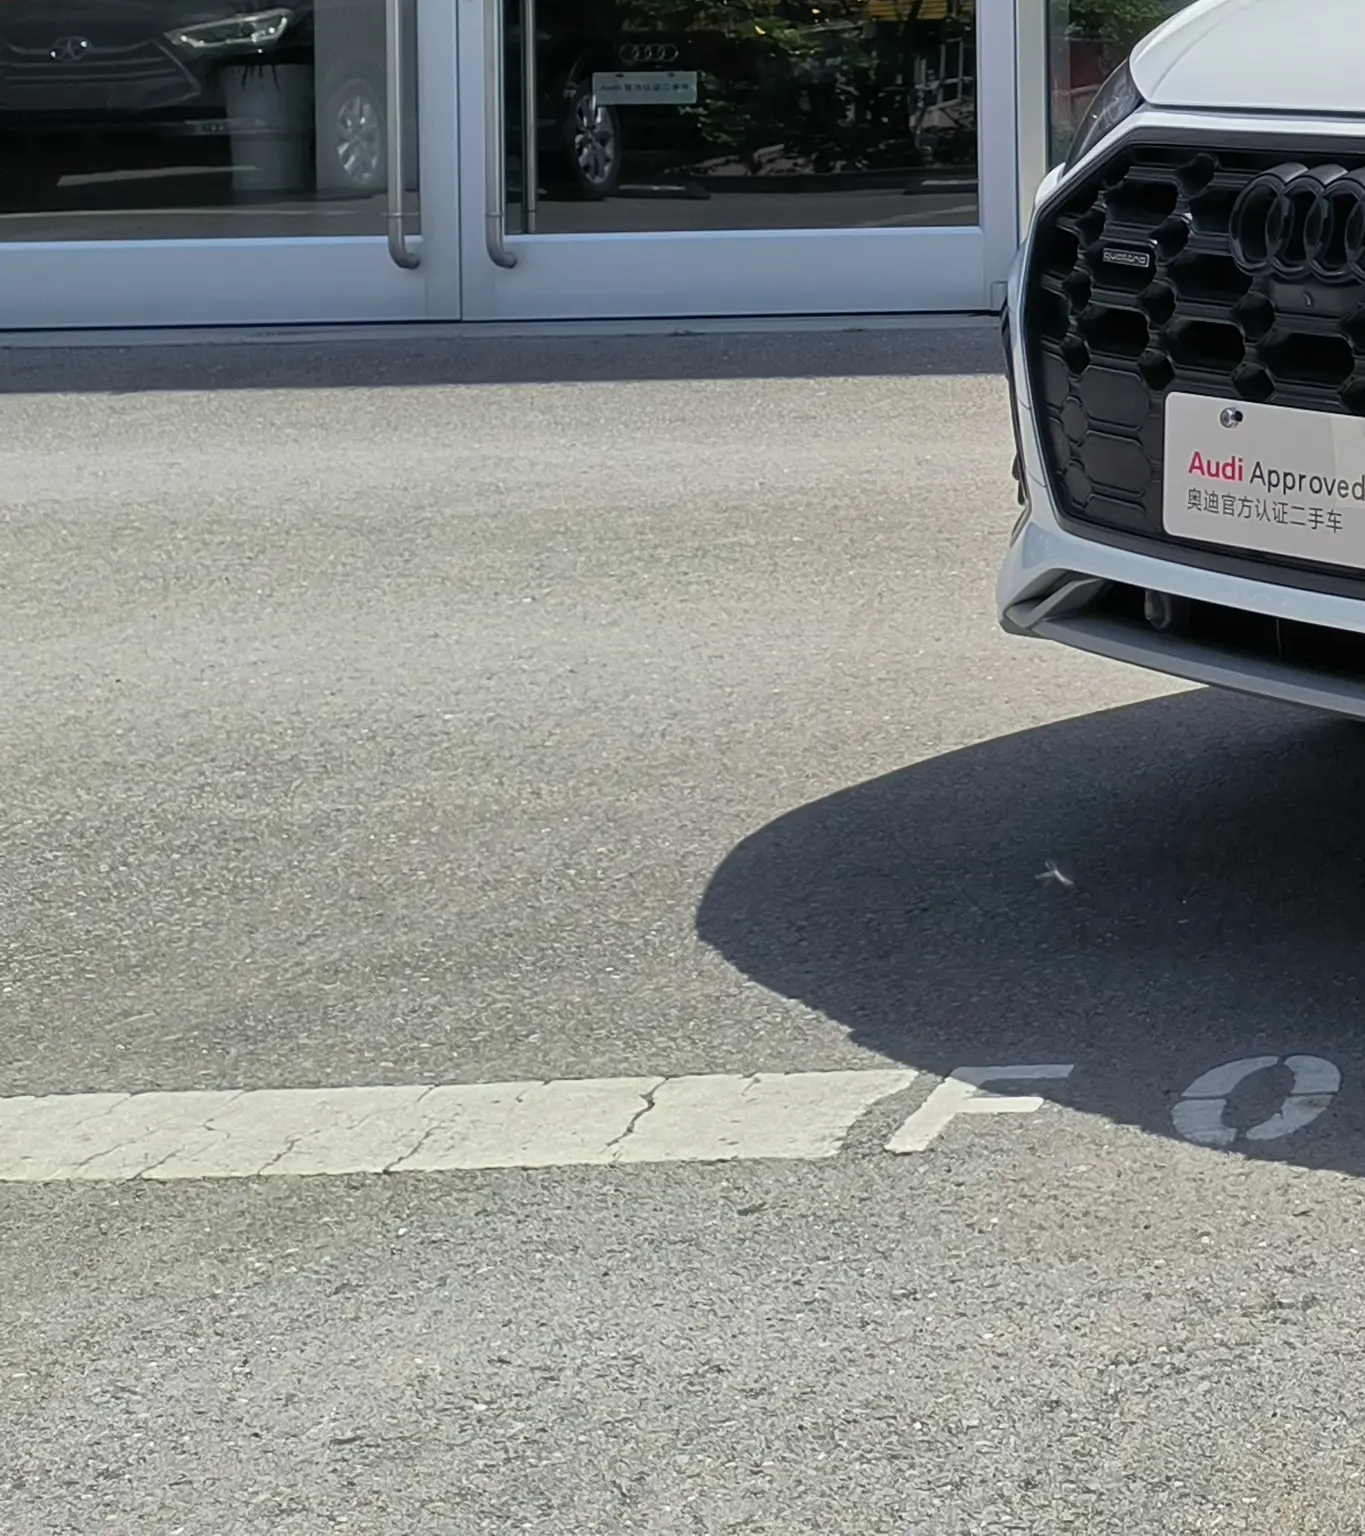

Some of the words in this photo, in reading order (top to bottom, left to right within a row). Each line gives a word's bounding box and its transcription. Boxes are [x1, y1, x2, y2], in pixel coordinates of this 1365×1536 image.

[1187, 451, 1243, 482] Audi
[1249, 461, 1365, 501] Approved
[1187, 487, 1344, 534] 奥迪官方认证二手车
